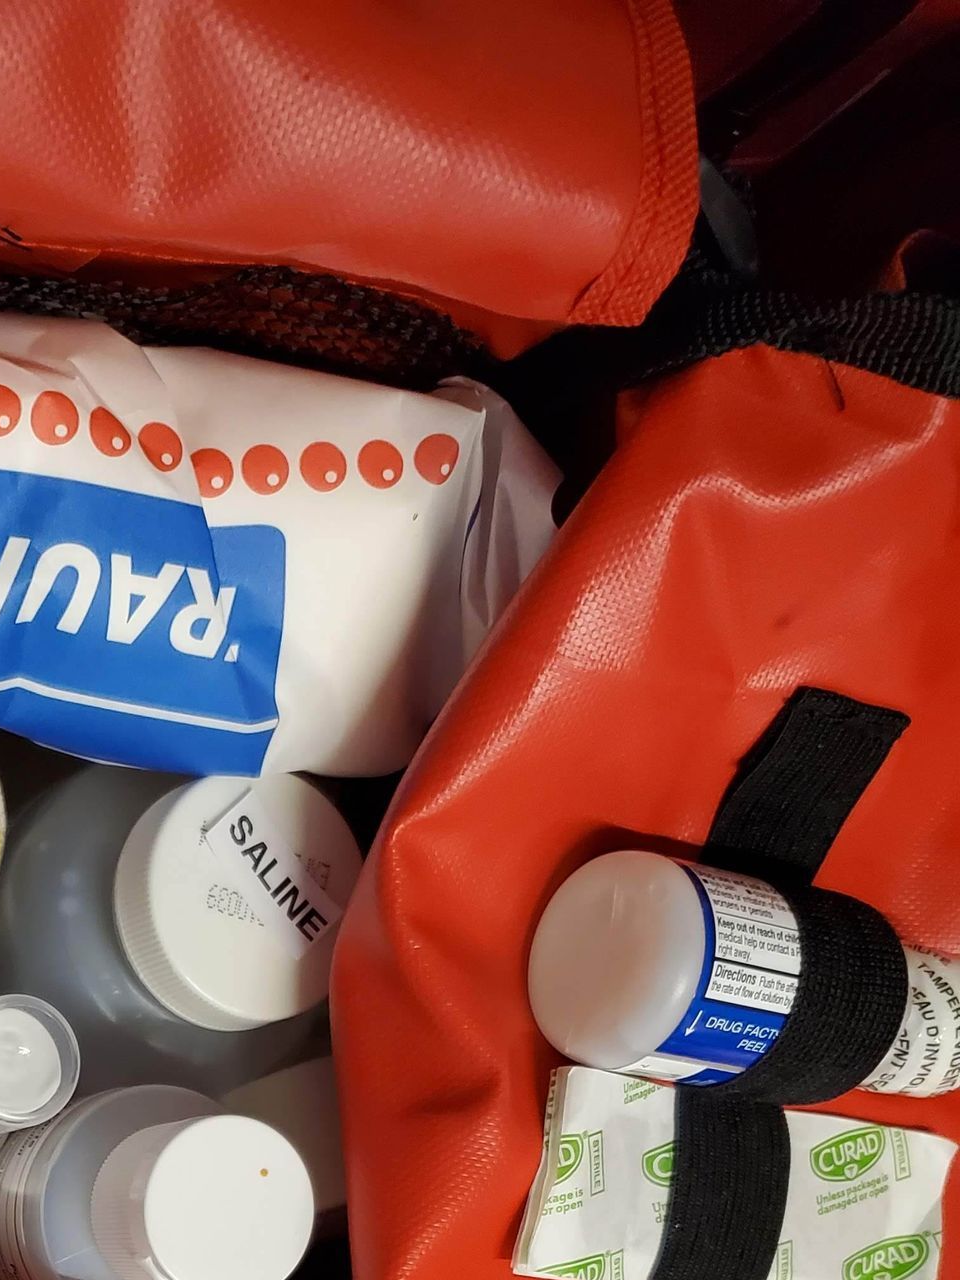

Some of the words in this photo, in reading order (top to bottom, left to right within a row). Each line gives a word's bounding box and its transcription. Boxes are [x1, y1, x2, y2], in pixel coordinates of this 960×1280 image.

[230, 815, 329, 942] SALINE
[717, 916, 736, 931] Keep
[736, 921, 749, 932] out
[748, 924, 756, 934] of
[756, 927, 776, 940] reach
[776, 931, 784, 942] of
[717, 931, 744, 945] medical
[743, 935, 758, 949] help
[758, 942, 767, 950] or
[766, 942, 790, 956] contact
[718, 943, 734, 957] right
[733, 947, 752, 961] away.
[714, 963, 757, 985] Directions
[759, 975, 776, 989] Flush
[775, 979, 786, 991] the
[917, 960, 960, 1021] TAMPER
[710, 979, 722, 991] the
[721, 984, 734, 995] rate
[733, 985, 742, 997] of
[741, 986, 754, 998] flow
[753, 988, 761, 1000] of
[760, 990, 785, 1005] solution
[705, 1016, 743, 1034] DRUG
[736, 1039, 768, 1054] PEEL
[592, 1139, 602, 1189] STERILE
[818, 1133, 880, 1173] CURAD
[816, 1190, 846, 1206] Unless
[845, 1176, 883, 1198] package
[817, 1195, 859, 1216] damaged
[859, 1192, 869, 1201] or
[868, 1184, 890, 1200] open
[554, 1200, 584, 1216] open
